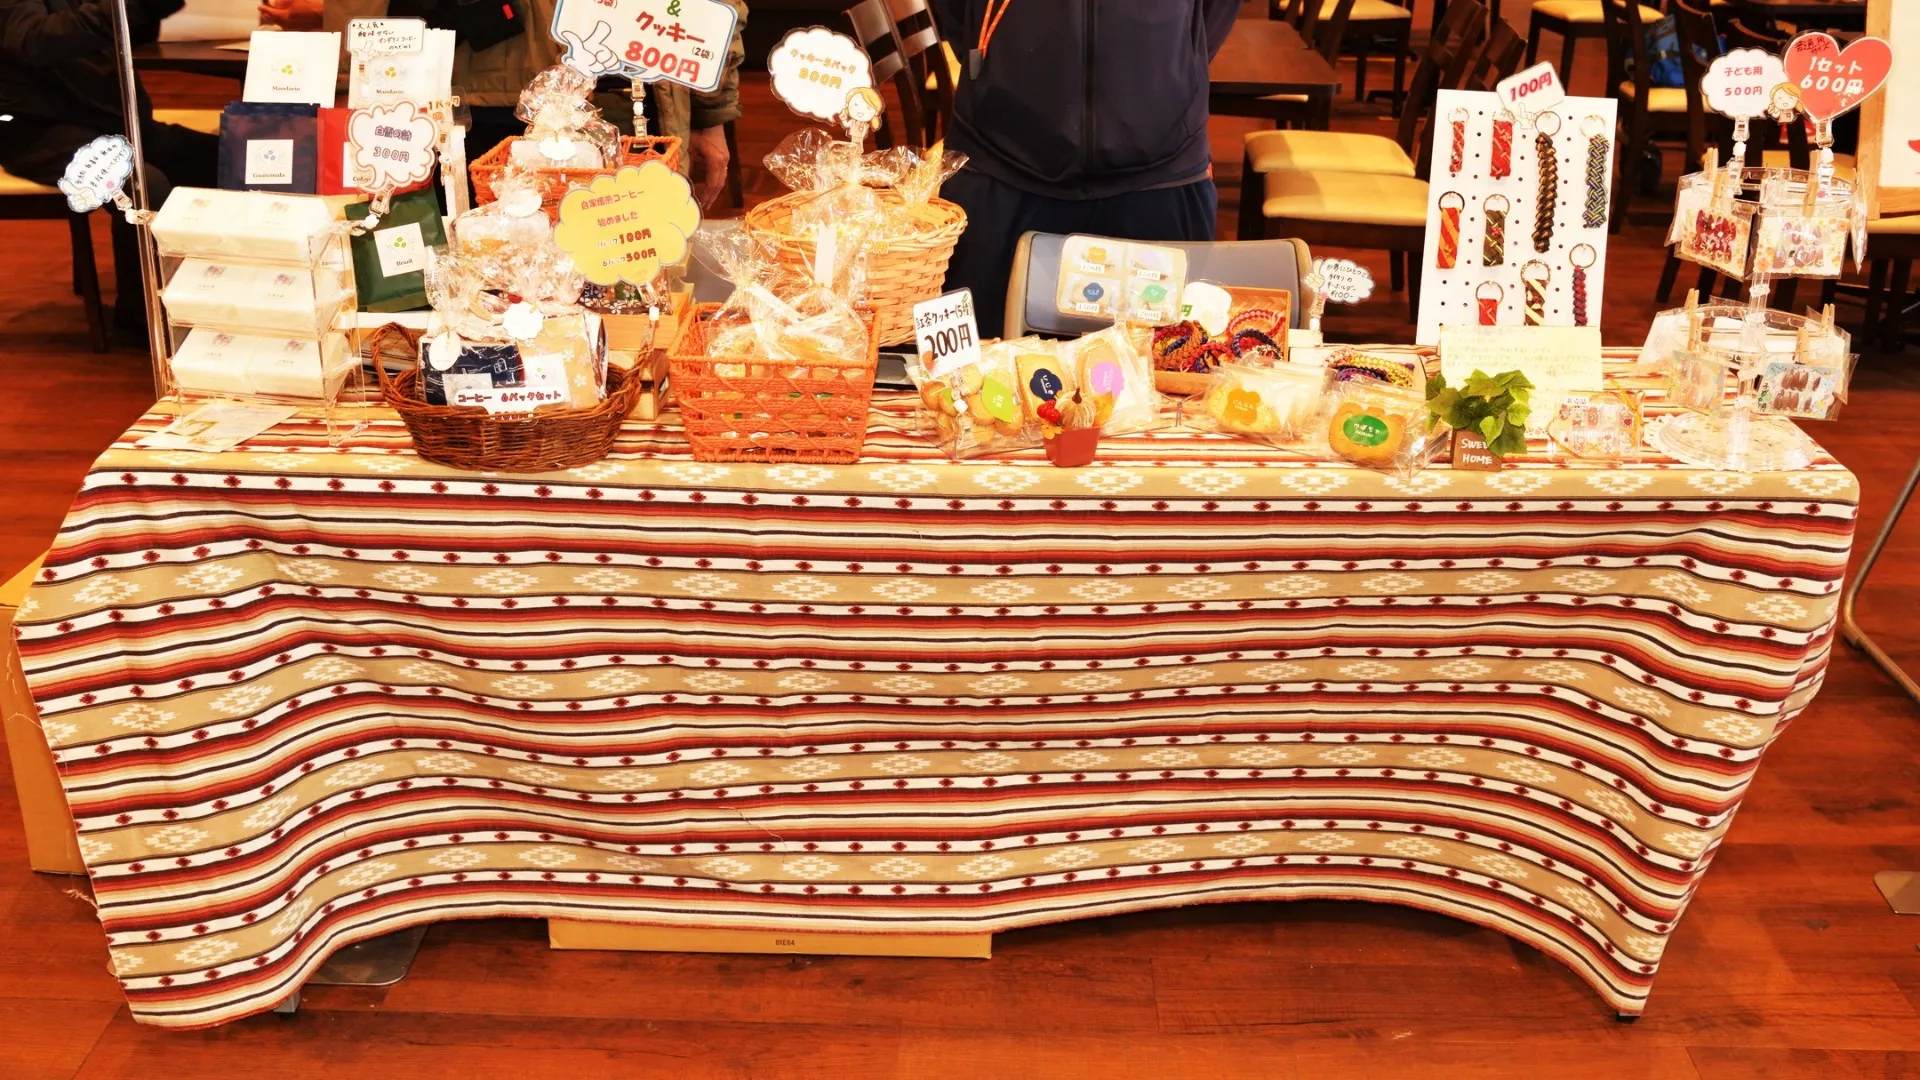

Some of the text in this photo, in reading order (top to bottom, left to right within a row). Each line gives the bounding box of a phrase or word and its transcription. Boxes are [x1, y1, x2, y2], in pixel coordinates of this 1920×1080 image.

[667, 0, 681, 17] &
[635, 11, 705, 43] クッキー
[691, 46, 714, 60] (2袋)
[624, 40, 700, 83] 800円
[1809, 56, 1863, 74] 1セット
[1724, 66, 1763, 76] 子ども用
[1510, 71, 1552, 102] 100円
[1724, 86, 1763, 96] 500円
[1800, 75, 1864, 95] 600円
[373, 146, 410, 162] 300円
[597, 211, 639, 227] 始めました
[924, 323, 973, 360] 200円
[457, 390, 561, 403] コーヒー 6パックセット
[1462, 453, 1493, 465] HOME
